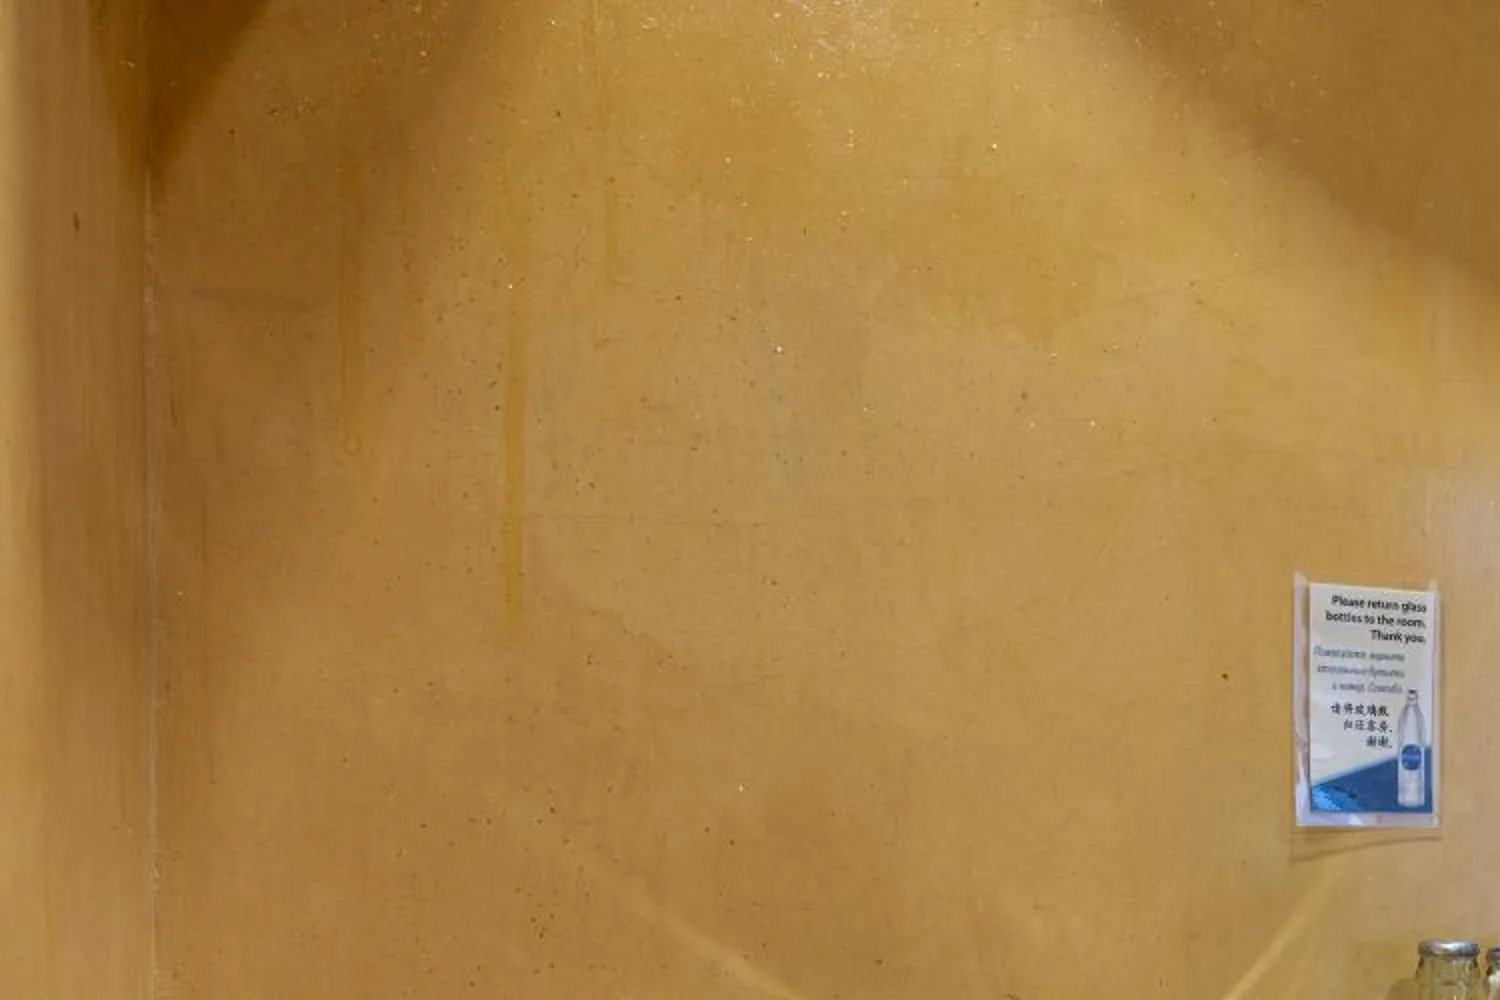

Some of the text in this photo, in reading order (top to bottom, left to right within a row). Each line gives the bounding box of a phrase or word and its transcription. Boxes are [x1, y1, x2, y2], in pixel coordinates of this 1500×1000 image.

[1331, 595, 1427, 614] Please return glass
[1325, 610, 1426, 628] bottles to the room.
[1370, 629, 1426, 645] Thank you.
